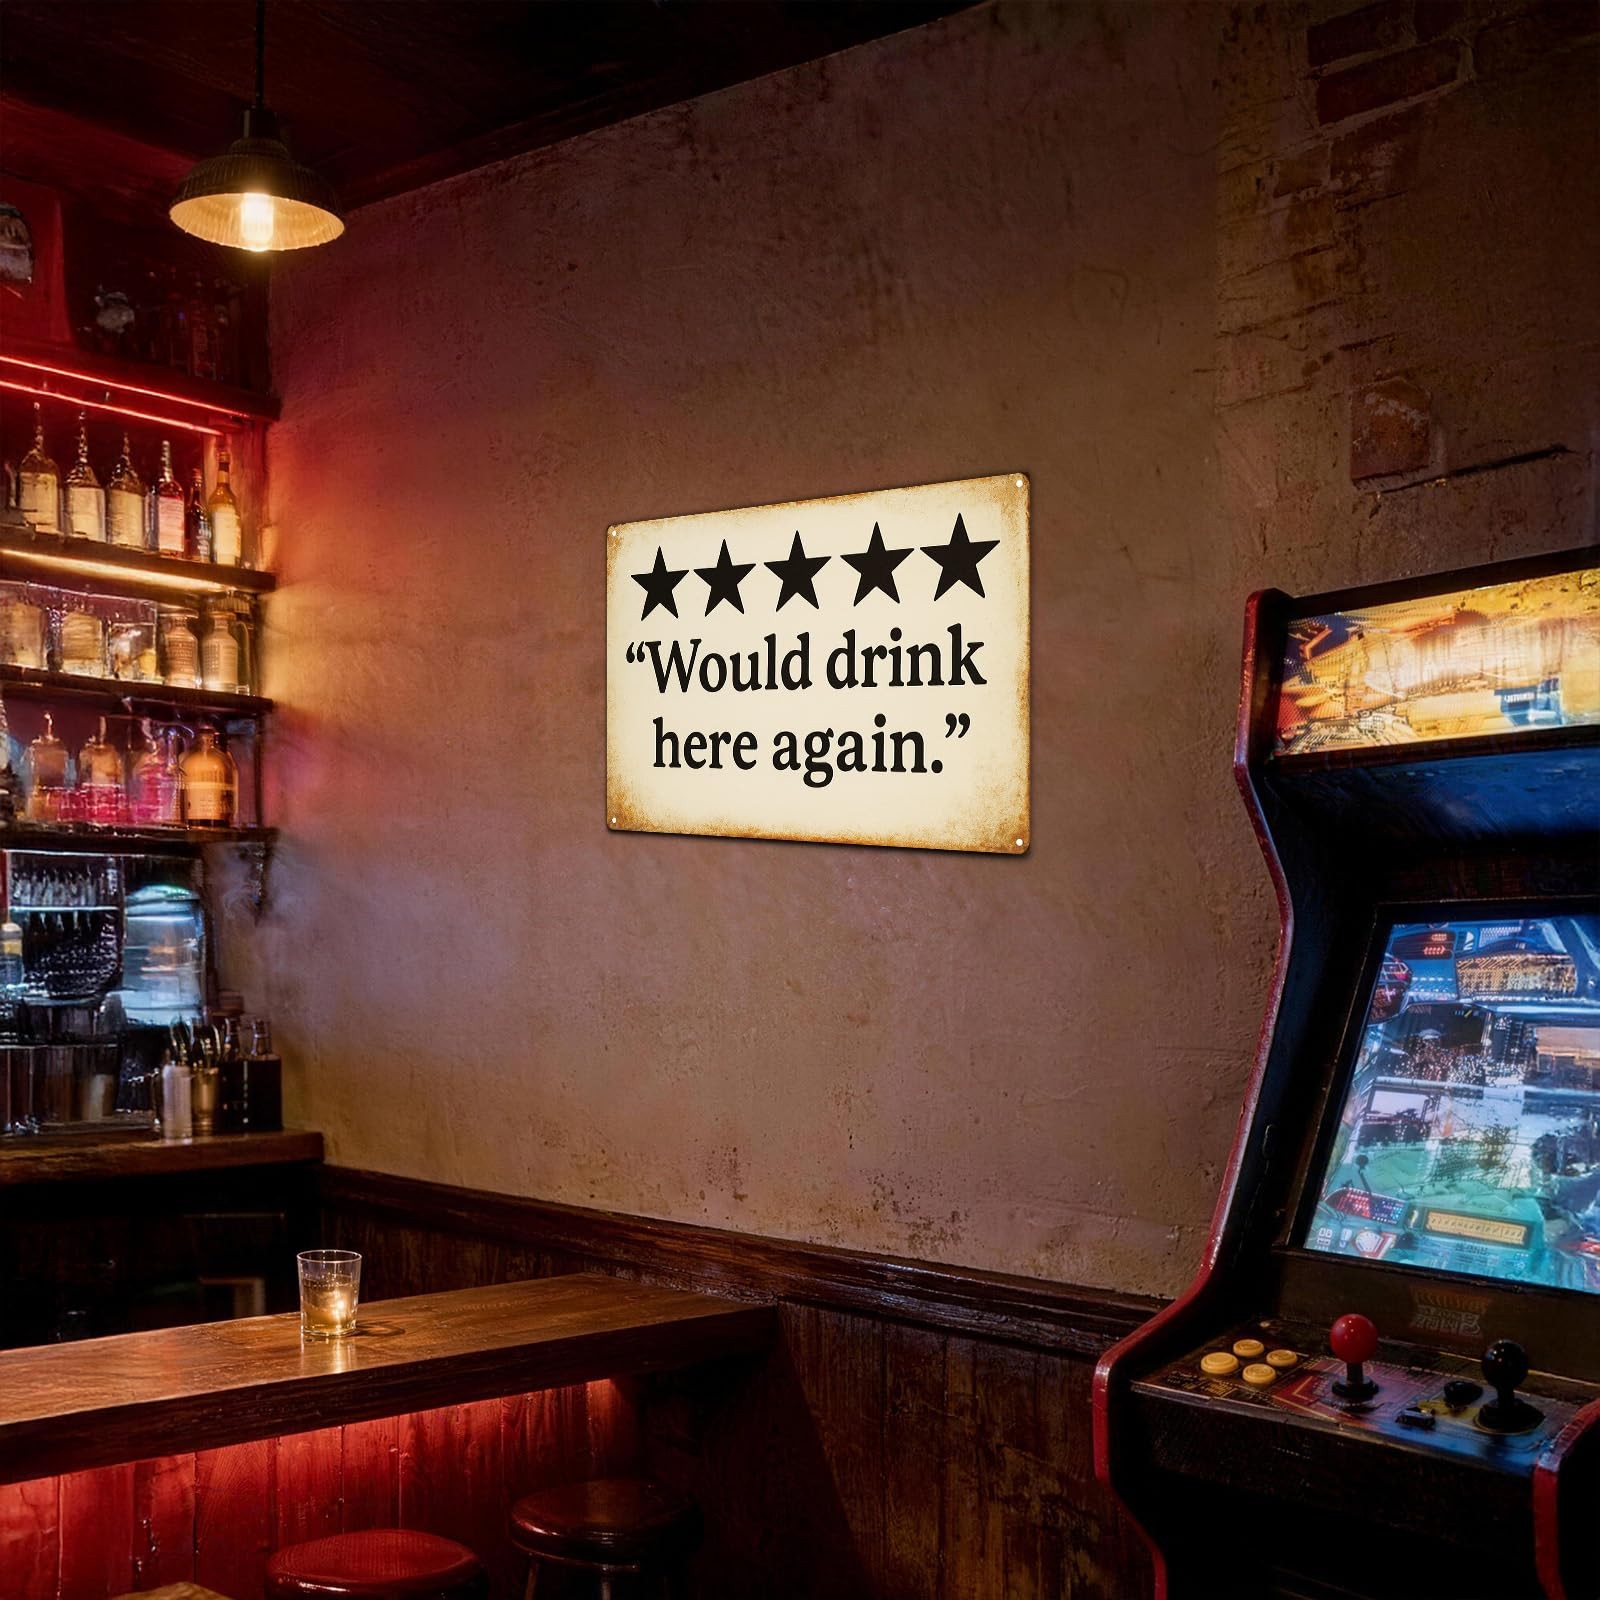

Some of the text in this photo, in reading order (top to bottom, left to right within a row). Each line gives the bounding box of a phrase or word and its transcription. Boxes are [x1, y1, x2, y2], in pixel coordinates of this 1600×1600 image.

[625, 622, 988, 694] “Would drink
[652, 712, 971, 789] here again.”
